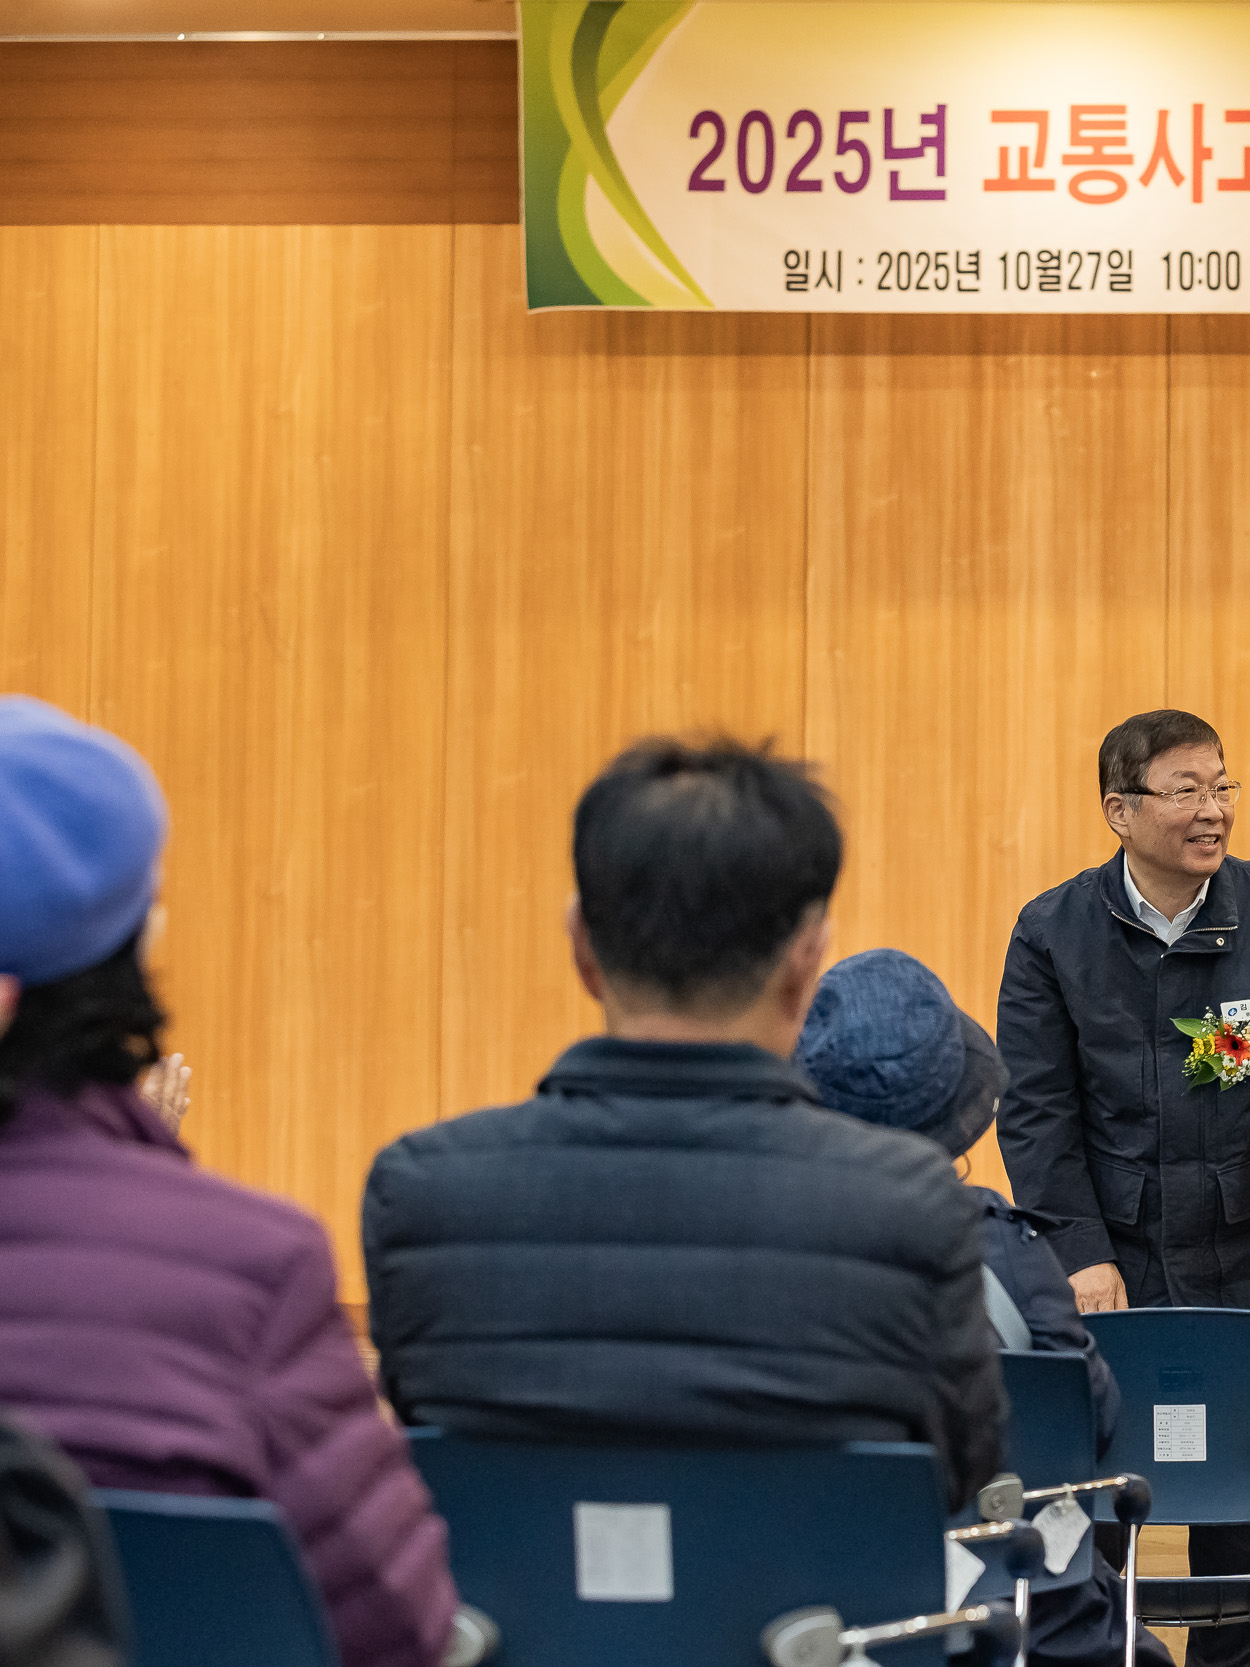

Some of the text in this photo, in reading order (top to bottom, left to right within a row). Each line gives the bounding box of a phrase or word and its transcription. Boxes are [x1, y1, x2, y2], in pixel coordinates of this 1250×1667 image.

[687, 103, 948, 202] 2025년
[783, 249, 843, 293] 일시
[877, 250, 981, 293] 2025년
[1000, 249, 1133, 293] 10월27일
[1163, 250, 1241, 292] 10:00
